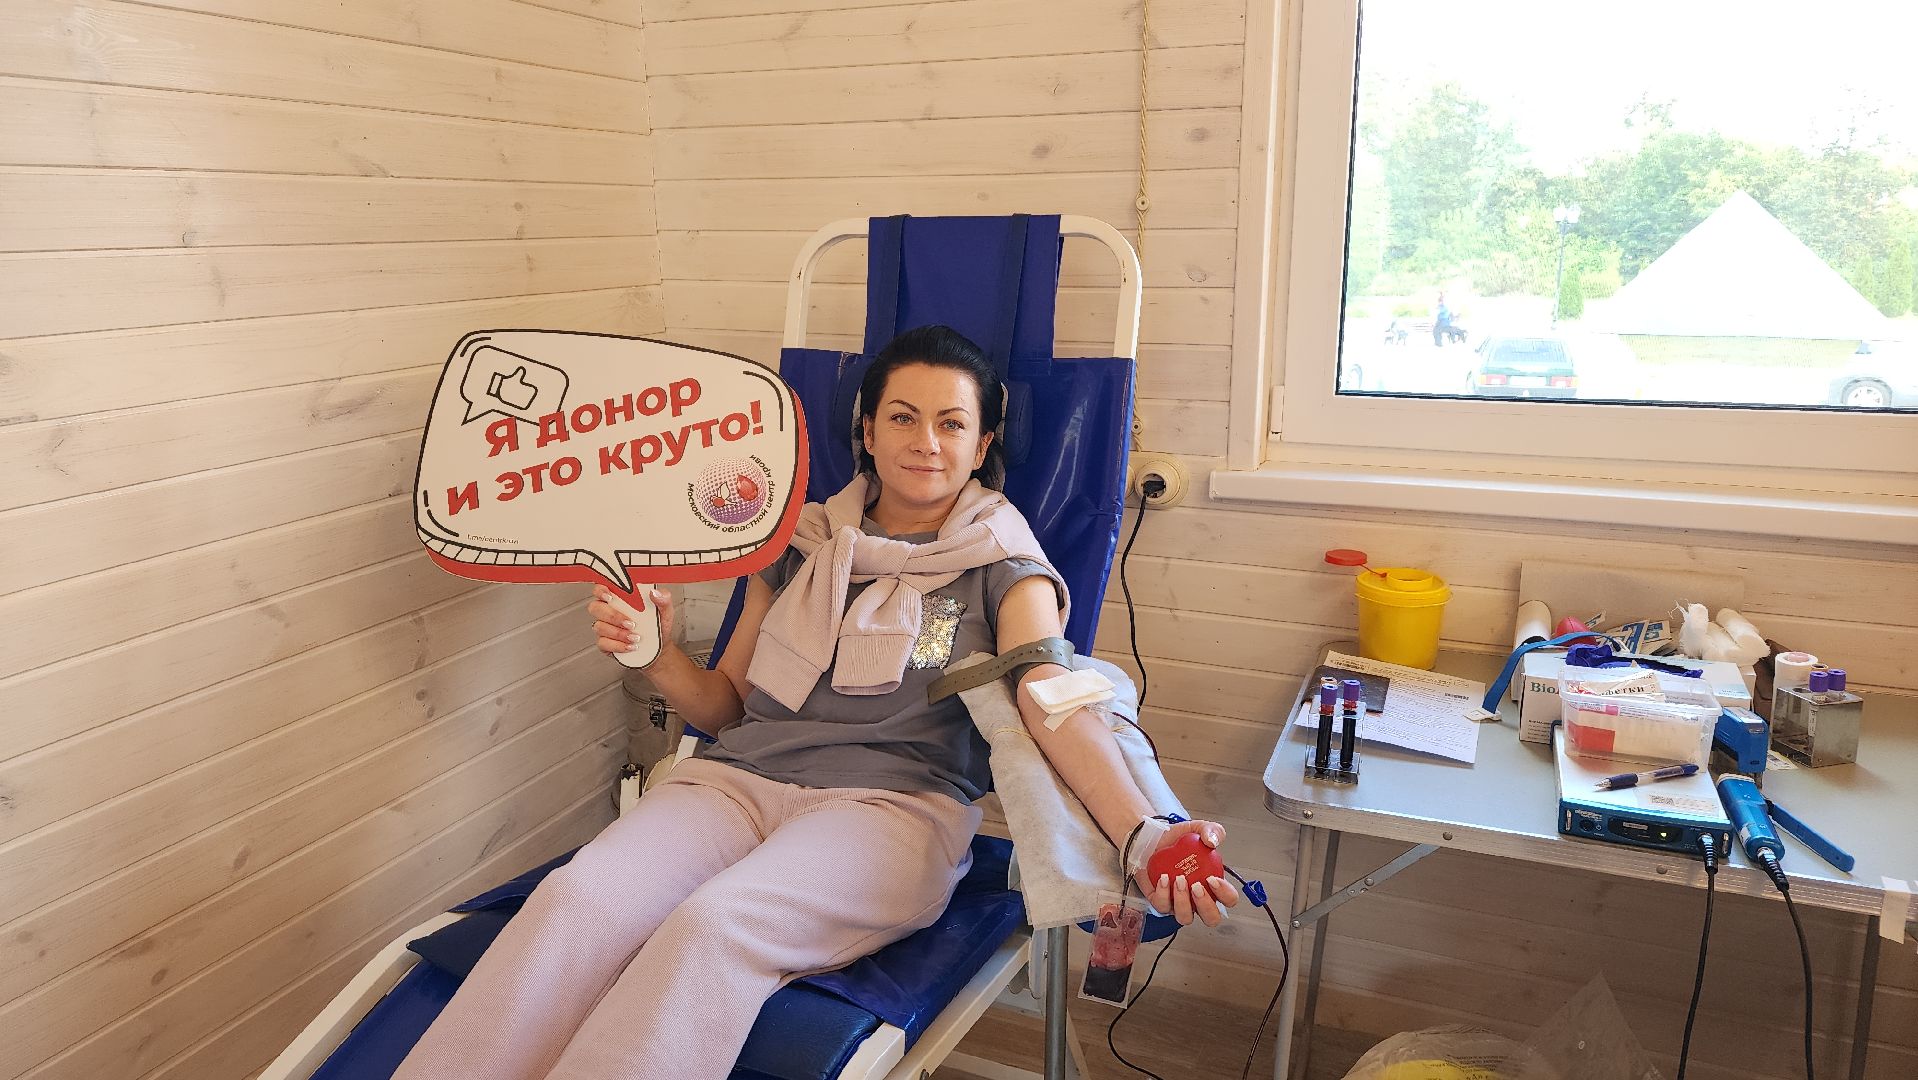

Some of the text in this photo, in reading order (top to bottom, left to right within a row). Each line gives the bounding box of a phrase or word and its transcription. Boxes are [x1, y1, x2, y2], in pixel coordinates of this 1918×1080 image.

[446, 400, 764, 516] и это круто!
[485, 377, 702, 458] Я донор
[687, 454, 776, 533] Московский областной центр крови
